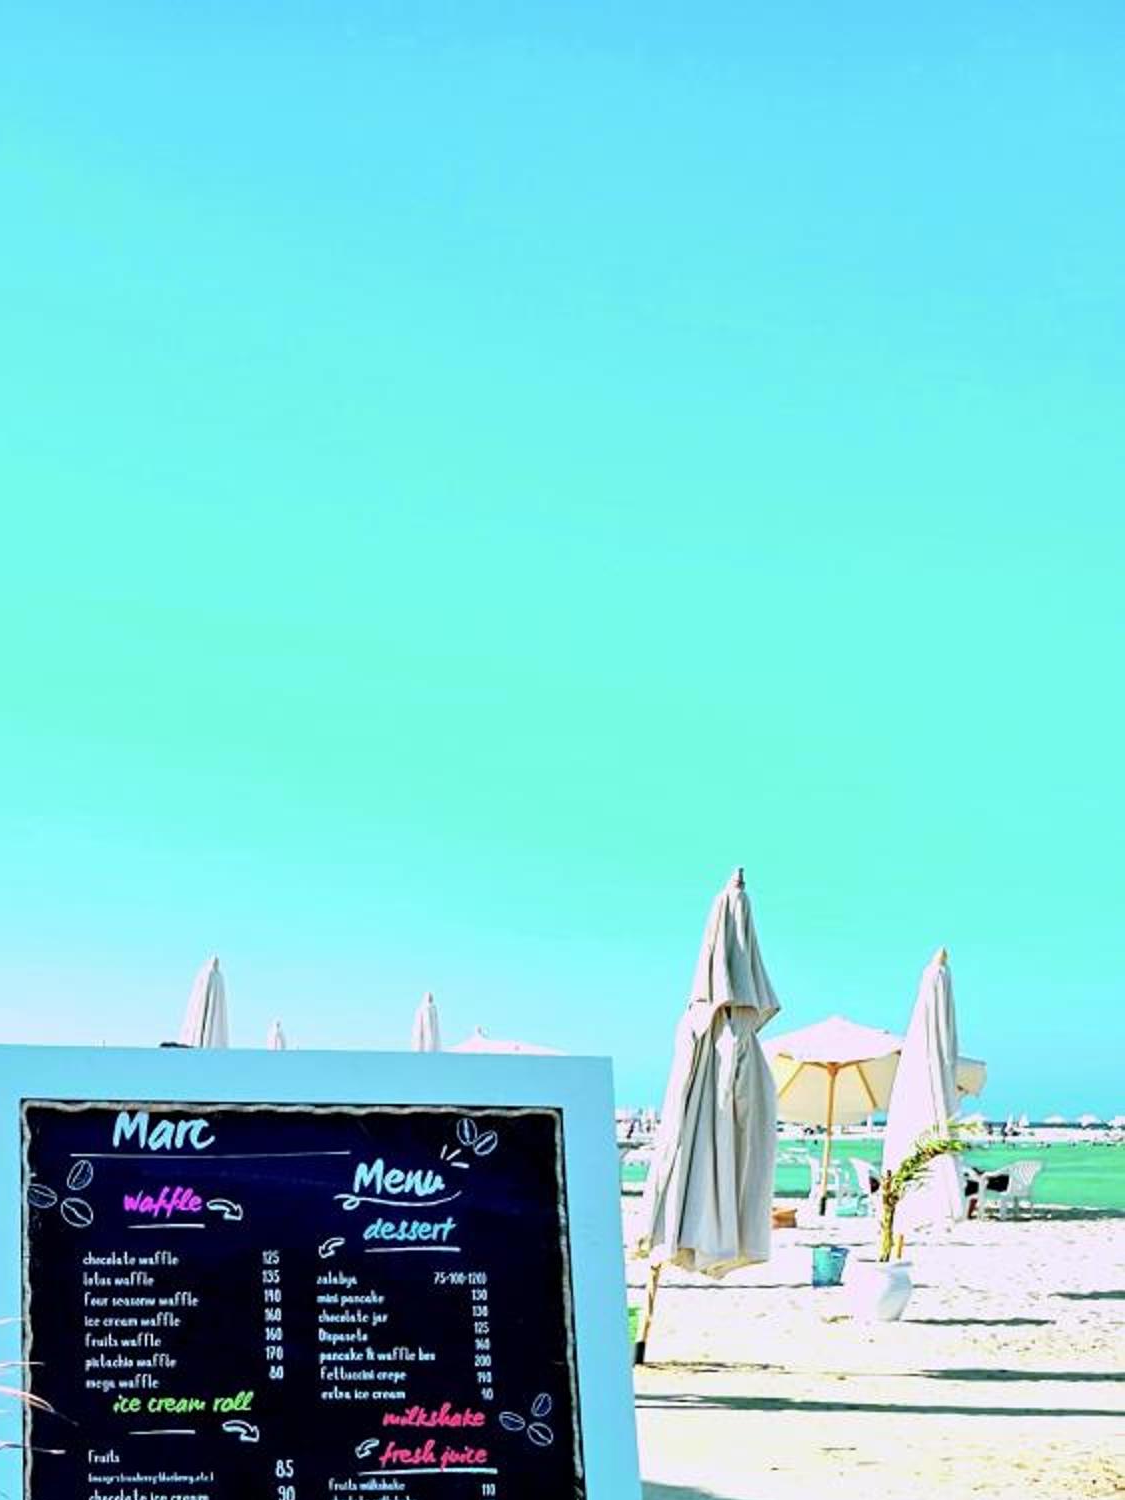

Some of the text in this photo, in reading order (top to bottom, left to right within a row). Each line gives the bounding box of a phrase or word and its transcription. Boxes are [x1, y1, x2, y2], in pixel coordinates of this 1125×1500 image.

[113, 1110, 215, 1151] Marc
[352, 1157, 445, 1197] Menu
[123, 1186, 202, 1217] waffle
[363, 1217, 456, 1241] dessert
[83, 1251, 178, 1265] chocolate waffle
[263, 1250, 279, 1264] 125
[83, 1272, 154, 1286] lotus waffle
[85, 1292, 108, 1306] four
[159, 1292, 198, 1306] waffle
[341, 1290, 384, 1306] pancake
[85, 1312, 180, 1326] ice cream waffle
[319, 1310, 369, 1322] chocolate
[85, 1332, 161, 1347] fruits waffle
[85, 1353, 176, 1370] pistachio waffle
[320, 1348, 363, 1364] pancake
[377, 1347, 416, 1360] waffle
[119, 1374, 158, 1388] waffle
[113, 1391, 253, 1413] ice cream roll
[355, 1390, 369, 1399] ice
[383, 1402, 485, 1427] milkshake
[378, 1440, 489, 1470] fresh juice
[276, 1460, 293, 1478] 85
